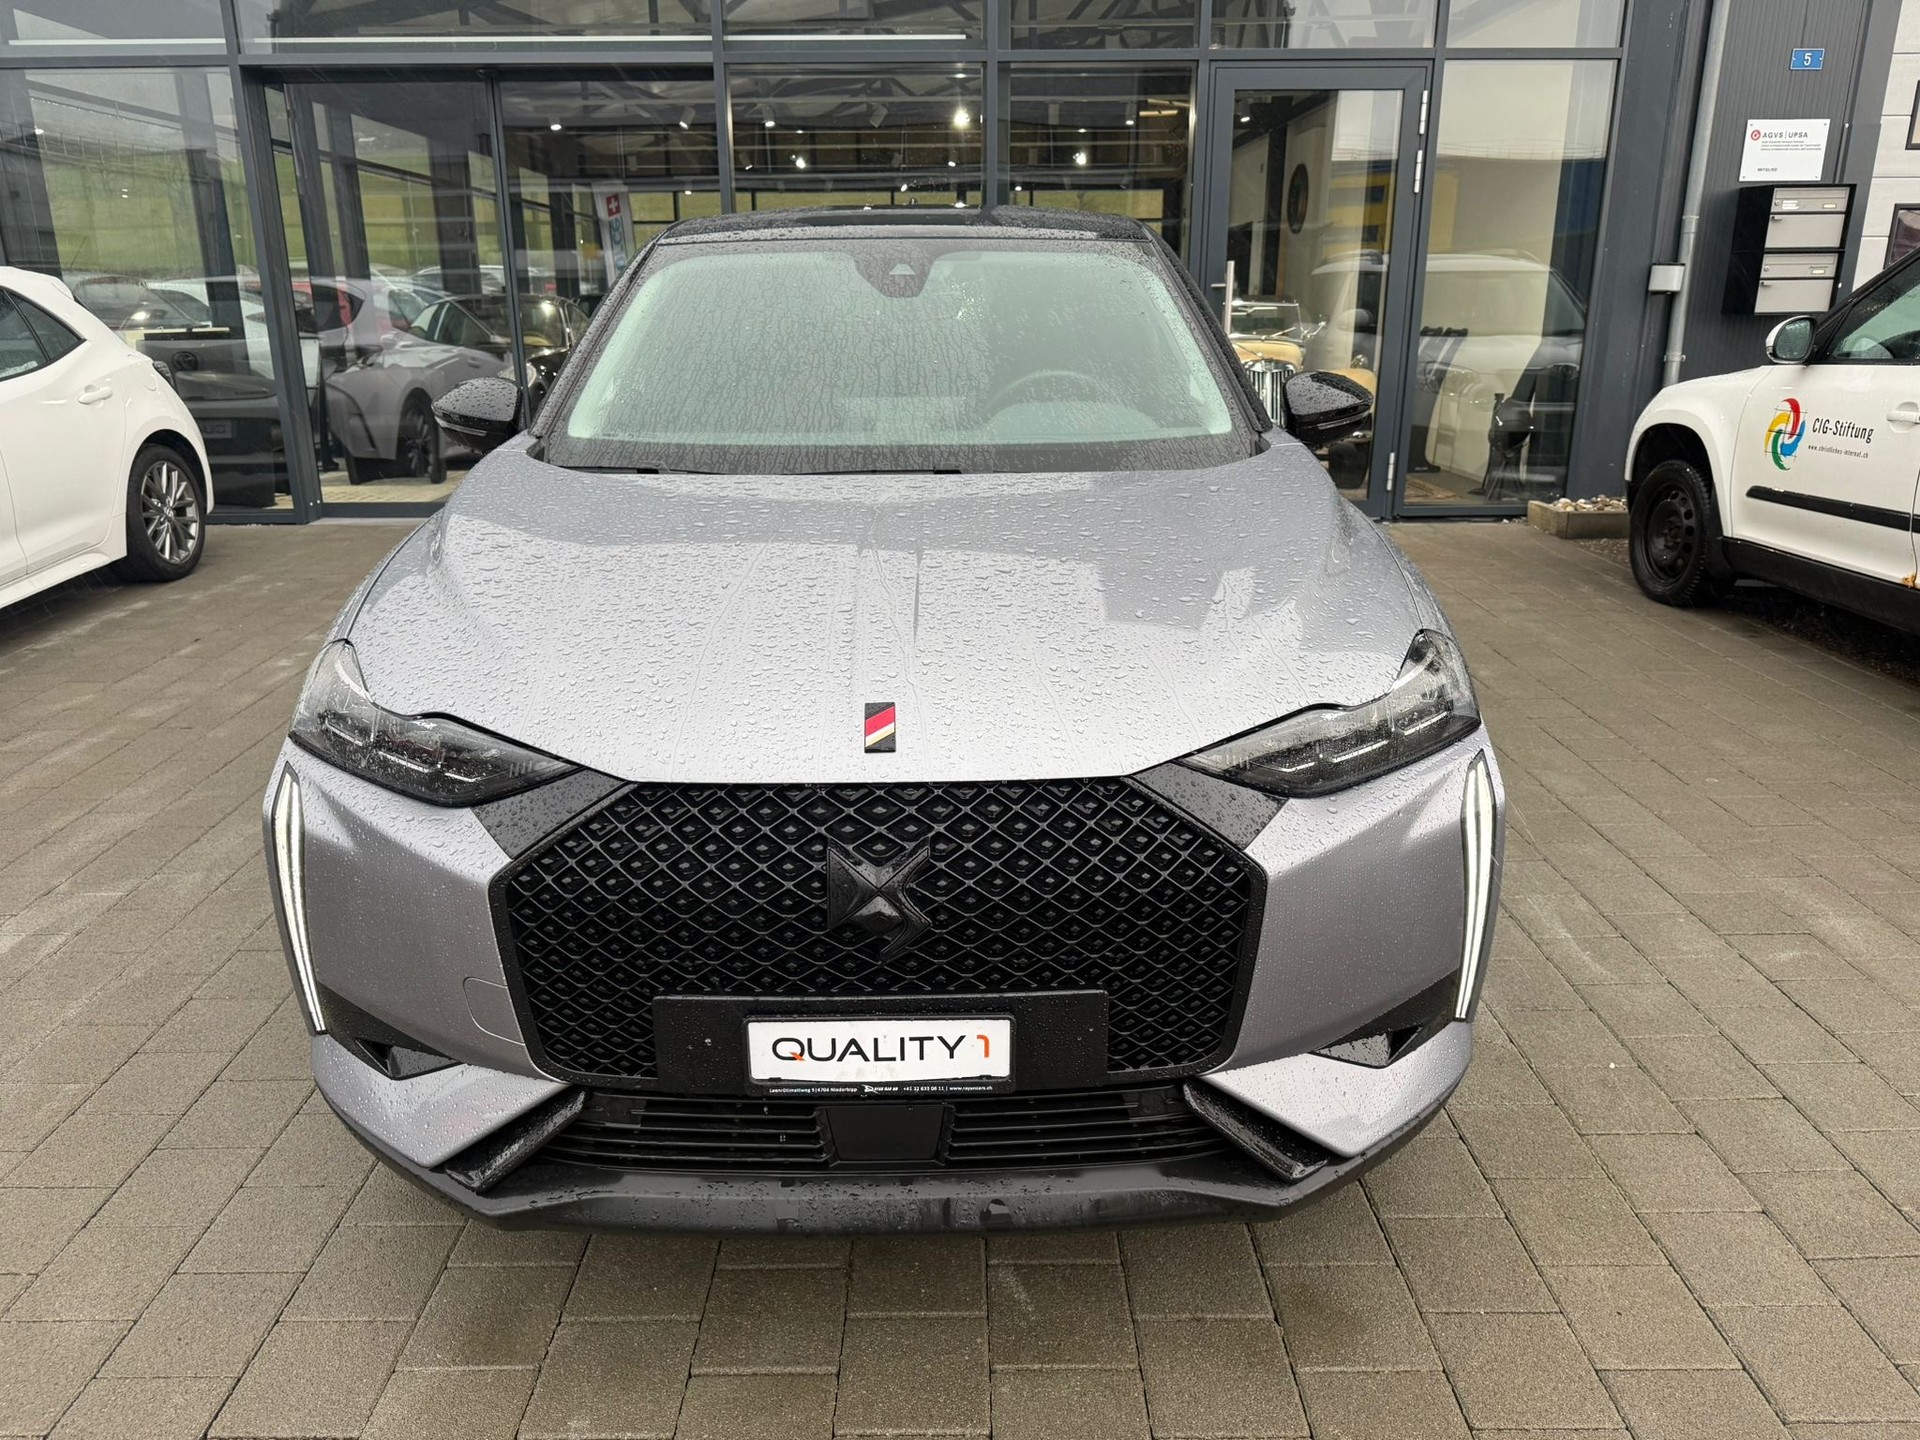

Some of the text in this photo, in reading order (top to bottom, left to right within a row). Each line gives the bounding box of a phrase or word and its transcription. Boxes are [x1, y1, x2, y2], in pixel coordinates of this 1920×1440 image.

[1803, 52, 1812, 66] 5
[1762, 131, 1784, 139] AGVS
[1812, 417, 1875, 444] CIG-Stiftung
[771, 1034, 966, 1062] QUALITY
